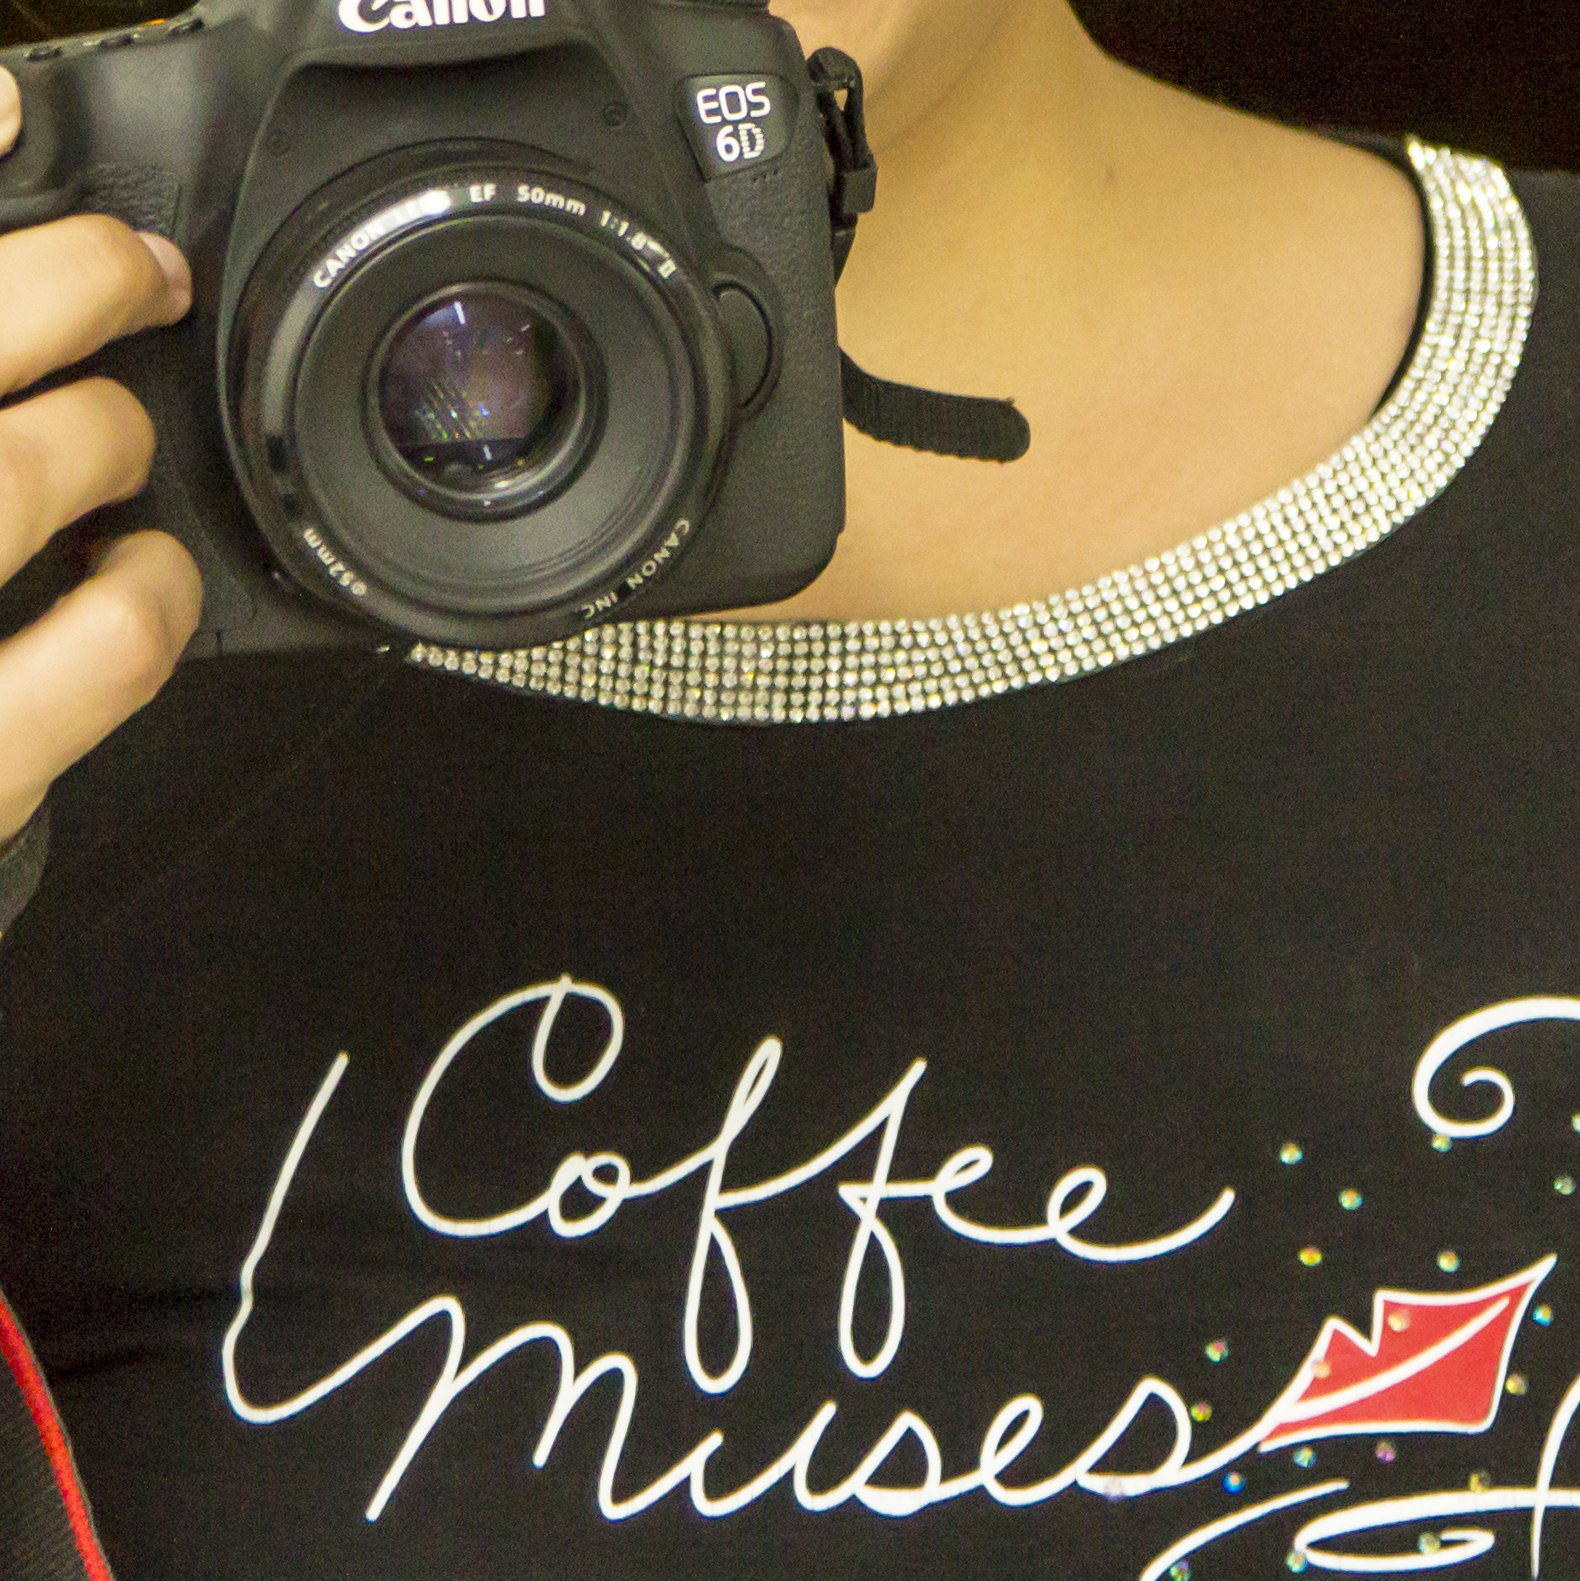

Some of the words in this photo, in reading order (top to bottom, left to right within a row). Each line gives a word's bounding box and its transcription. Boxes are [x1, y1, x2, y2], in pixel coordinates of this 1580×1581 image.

[696, 81, 772, 124] EOS
[716, 122, 765, 162] 6D
[313, 220, 386, 288] CANON
[469, 183, 497, 203] EF
[517, 184, 586, 216] 50mm
[626, 518, 690, 590] CANON
[402, 973, 1235, 1394] Coffee
